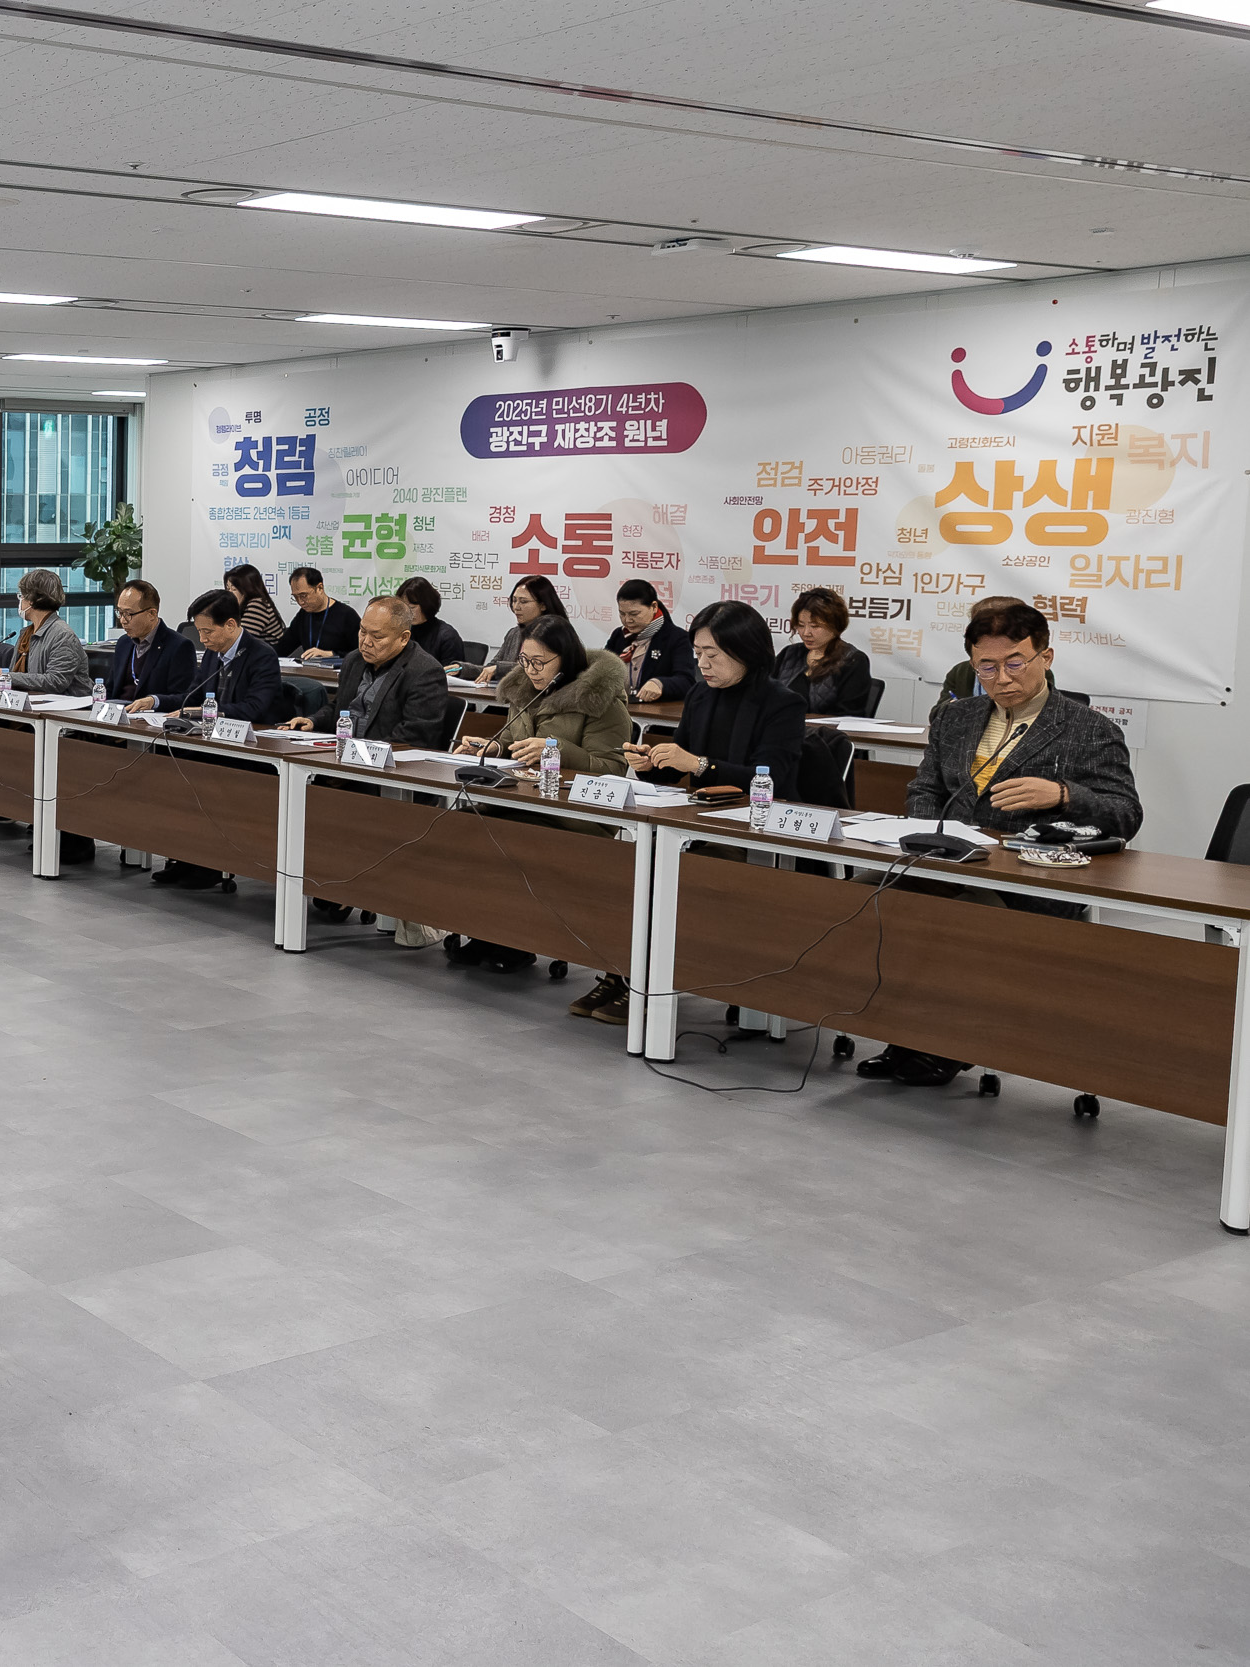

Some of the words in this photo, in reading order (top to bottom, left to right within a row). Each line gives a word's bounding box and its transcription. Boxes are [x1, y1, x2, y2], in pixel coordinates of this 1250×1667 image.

[1065, 331, 1135, 364] 소통하며
[1140, 325, 1218, 359] 발전하는
[1062, 356, 1217, 411] 행복광진
[495, 399, 547, 421] 2025년
[552, 394, 612, 418] 민선8기
[617, 391, 665, 414] 4년차
[245, 411, 262, 424] 투명
[304, 407, 331, 427] 공정
[489, 426, 548, 452] 광진구
[554, 422, 617, 449] 재창조
[624, 419, 668, 446] 원년
[1072, 423, 1119, 447] 지원
[842, 445, 913, 465] 아동권리
[1127, 431, 1210, 471] 복지
[212, 463, 229, 477] 긍정
[234, 434, 316, 497] 청렴
[756, 461, 804, 488] 점검
[346, 467, 400, 486] 아이디어
[807, 476, 880, 496] 주거안정
[392, 488, 419, 503] 2040
[421, 487, 468, 503] 광진플랜
[934, 458, 1115, 546] 상생
[209, 507, 251, 520] 종합청렴도
[253, 506, 286, 520] 2년연속
[288, 505, 310, 520] 1등급
[489, 505, 516, 524] 경청
[653, 503, 688, 526] 해결
[1126, 509, 1175, 524] 광진형
[272, 525, 291, 540] 의지
[413, 516, 435, 532] 청년
[622, 524, 643, 538] 현장
[219, 532, 271, 549] 청렴지킴이
[306, 535, 334, 556] 창출
[342, 512, 407, 560] 균형
[471, 530, 490, 542] 배려
[509, 513, 613, 578] 소통
[752, 507, 859, 567] 안전
[897, 527, 929, 544] 청년
[449, 552, 499, 570] 좋은친구
[621, 550, 681, 570] 직통문자
[698, 556, 743, 570] 식품안전
[1002, 555, 1050, 567] 소상공인
[470, 575, 503, 590] 진정성
[860, 562, 903, 586] 안심
[1069, 554, 1183, 591] 일자리
[913, 572, 986, 596] 1인가구
[721, 584, 779, 608] 비우기
[1033, 595, 1088, 624] 협력
[869, 626, 923, 657] 활력
[1058, 630, 1127, 648] 복지서비스
